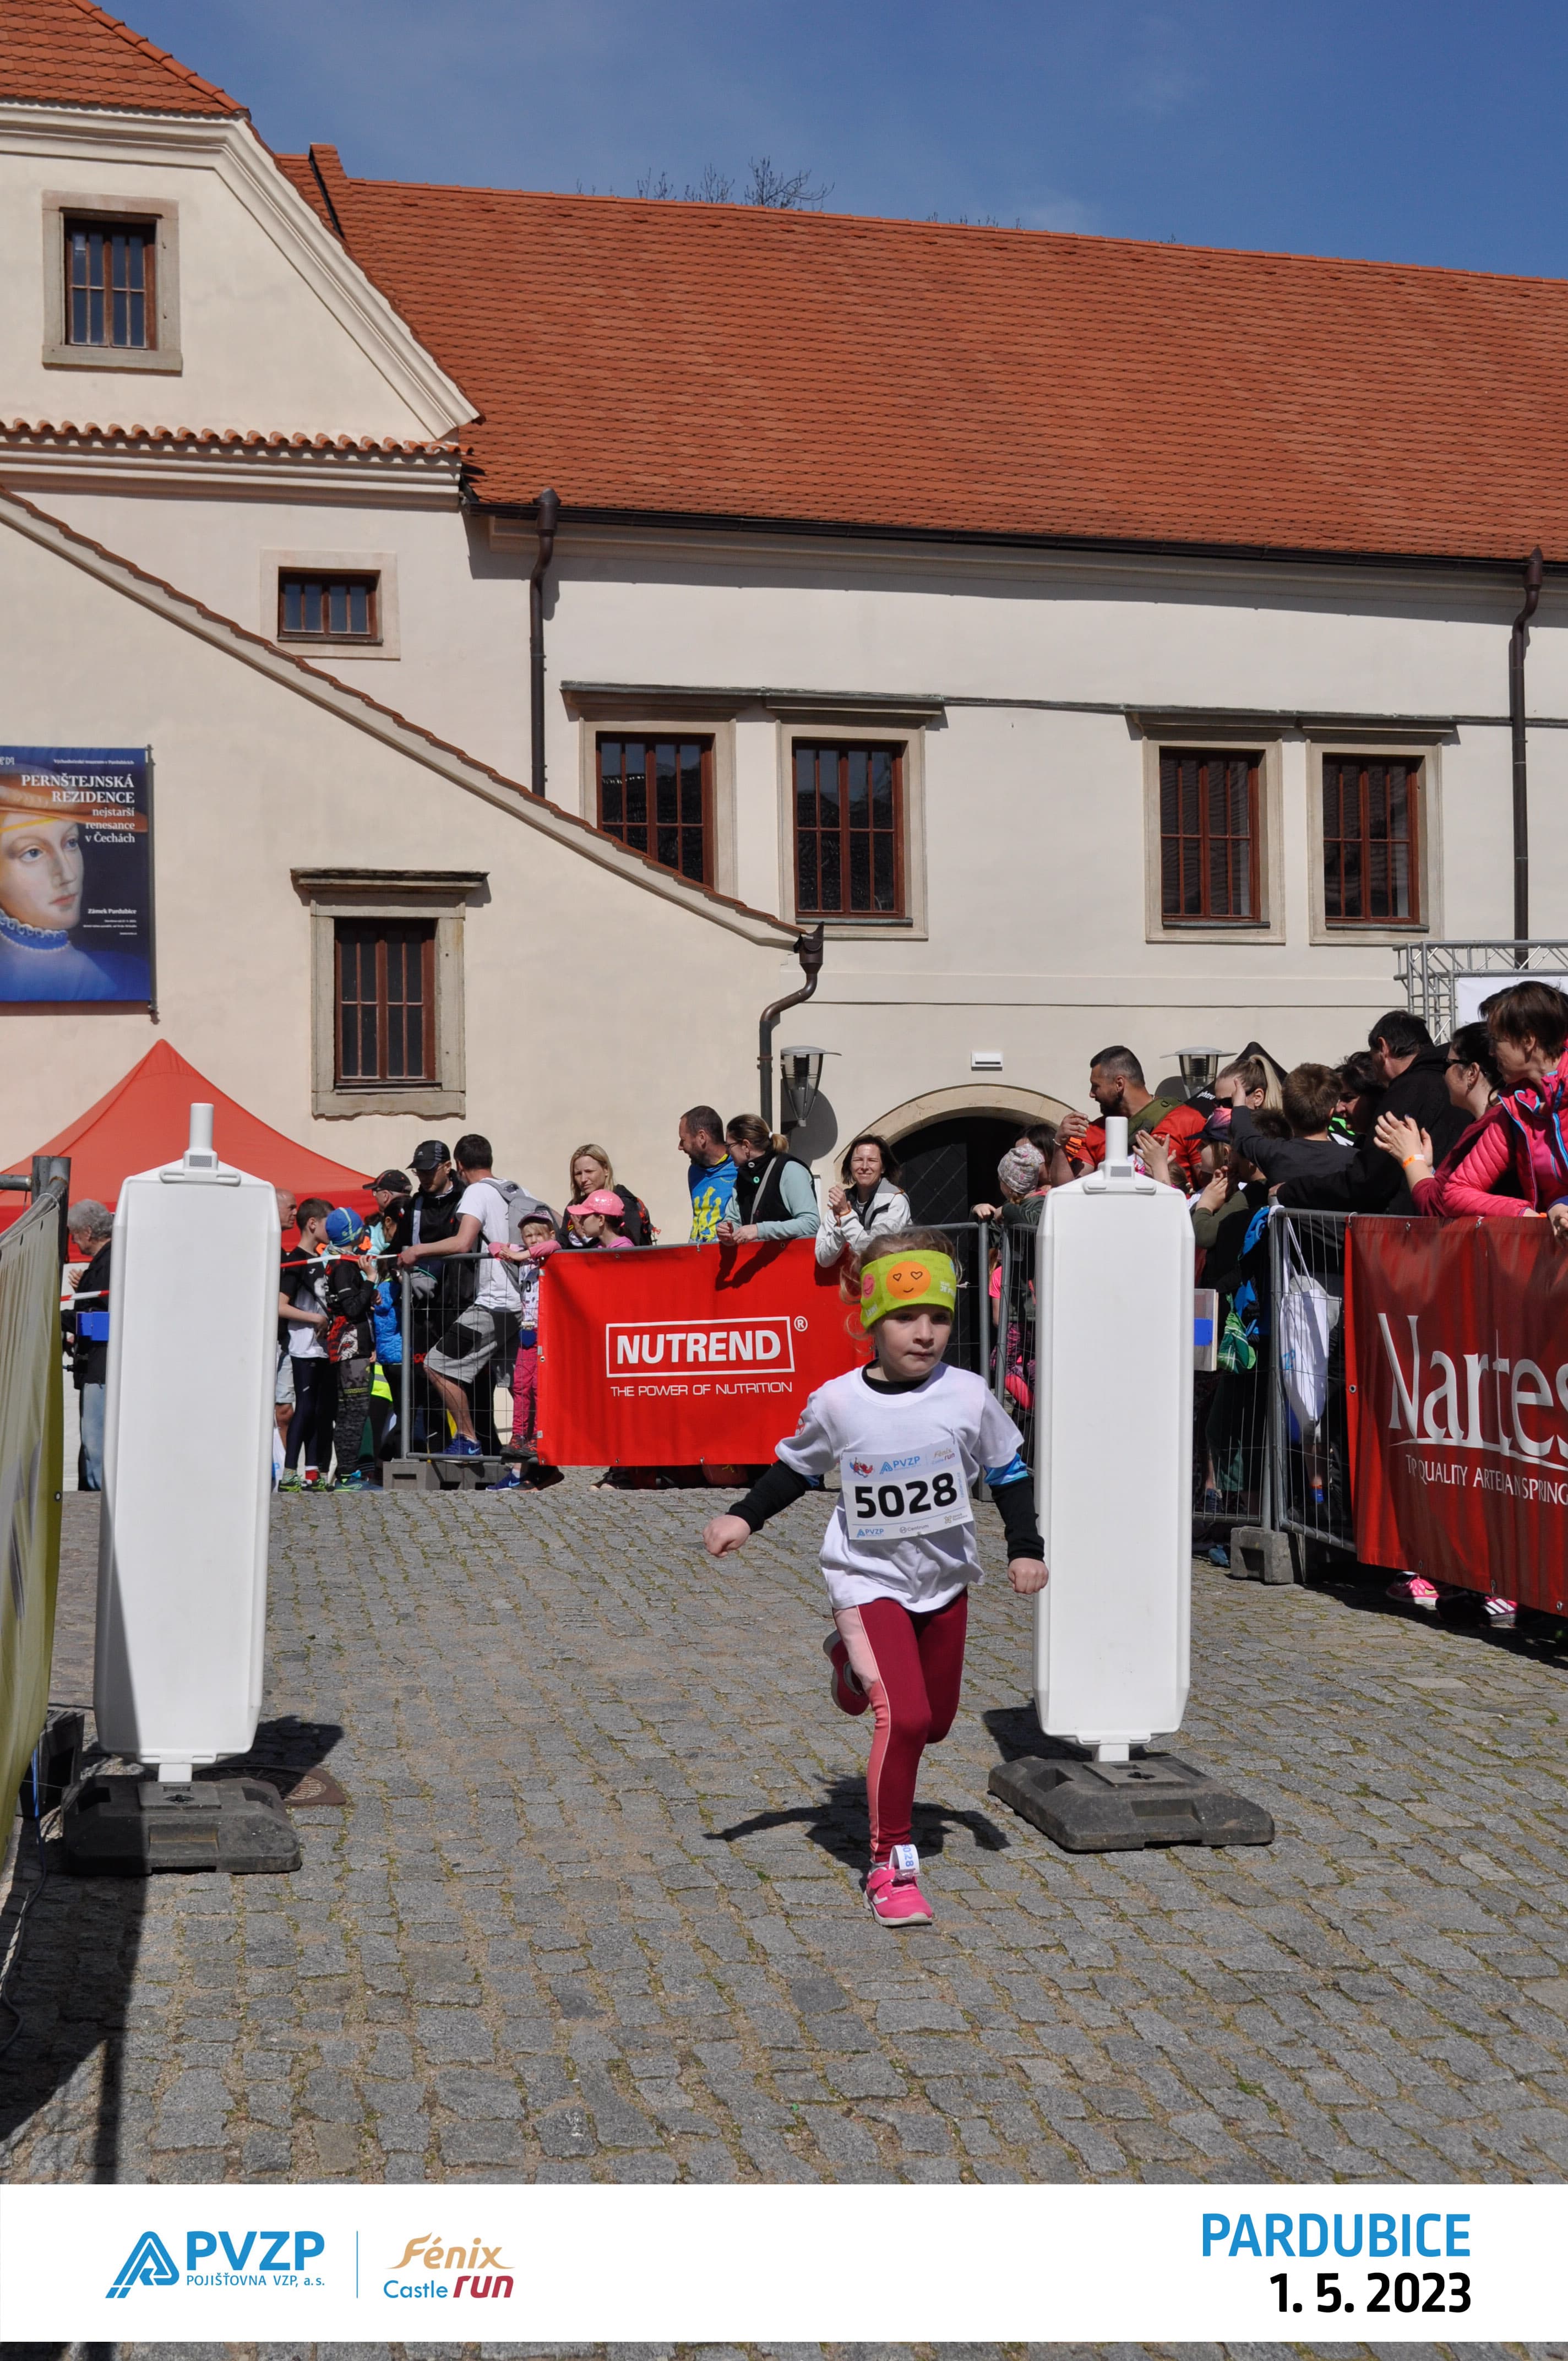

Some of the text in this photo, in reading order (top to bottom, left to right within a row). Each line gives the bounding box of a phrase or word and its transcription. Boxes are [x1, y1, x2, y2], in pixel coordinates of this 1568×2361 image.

[21, 773, 134, 788] PERNŠTEJNSKÁ
[52, 790, 135, 803] REZIDENCE
[92, 807, 135, 818] nejstarší
[94, 832, 135, 843] Čechách
[617, 1330, 781, 1364] NUTREND
[611, 1381, 793, 1397] THE POWER OF NUTRITION
[893, 1456, 921, 1468] PVZP
[1418, 1460, 1468, 1486] QUALITY
[854, 1472, 957, 1519] 5028
